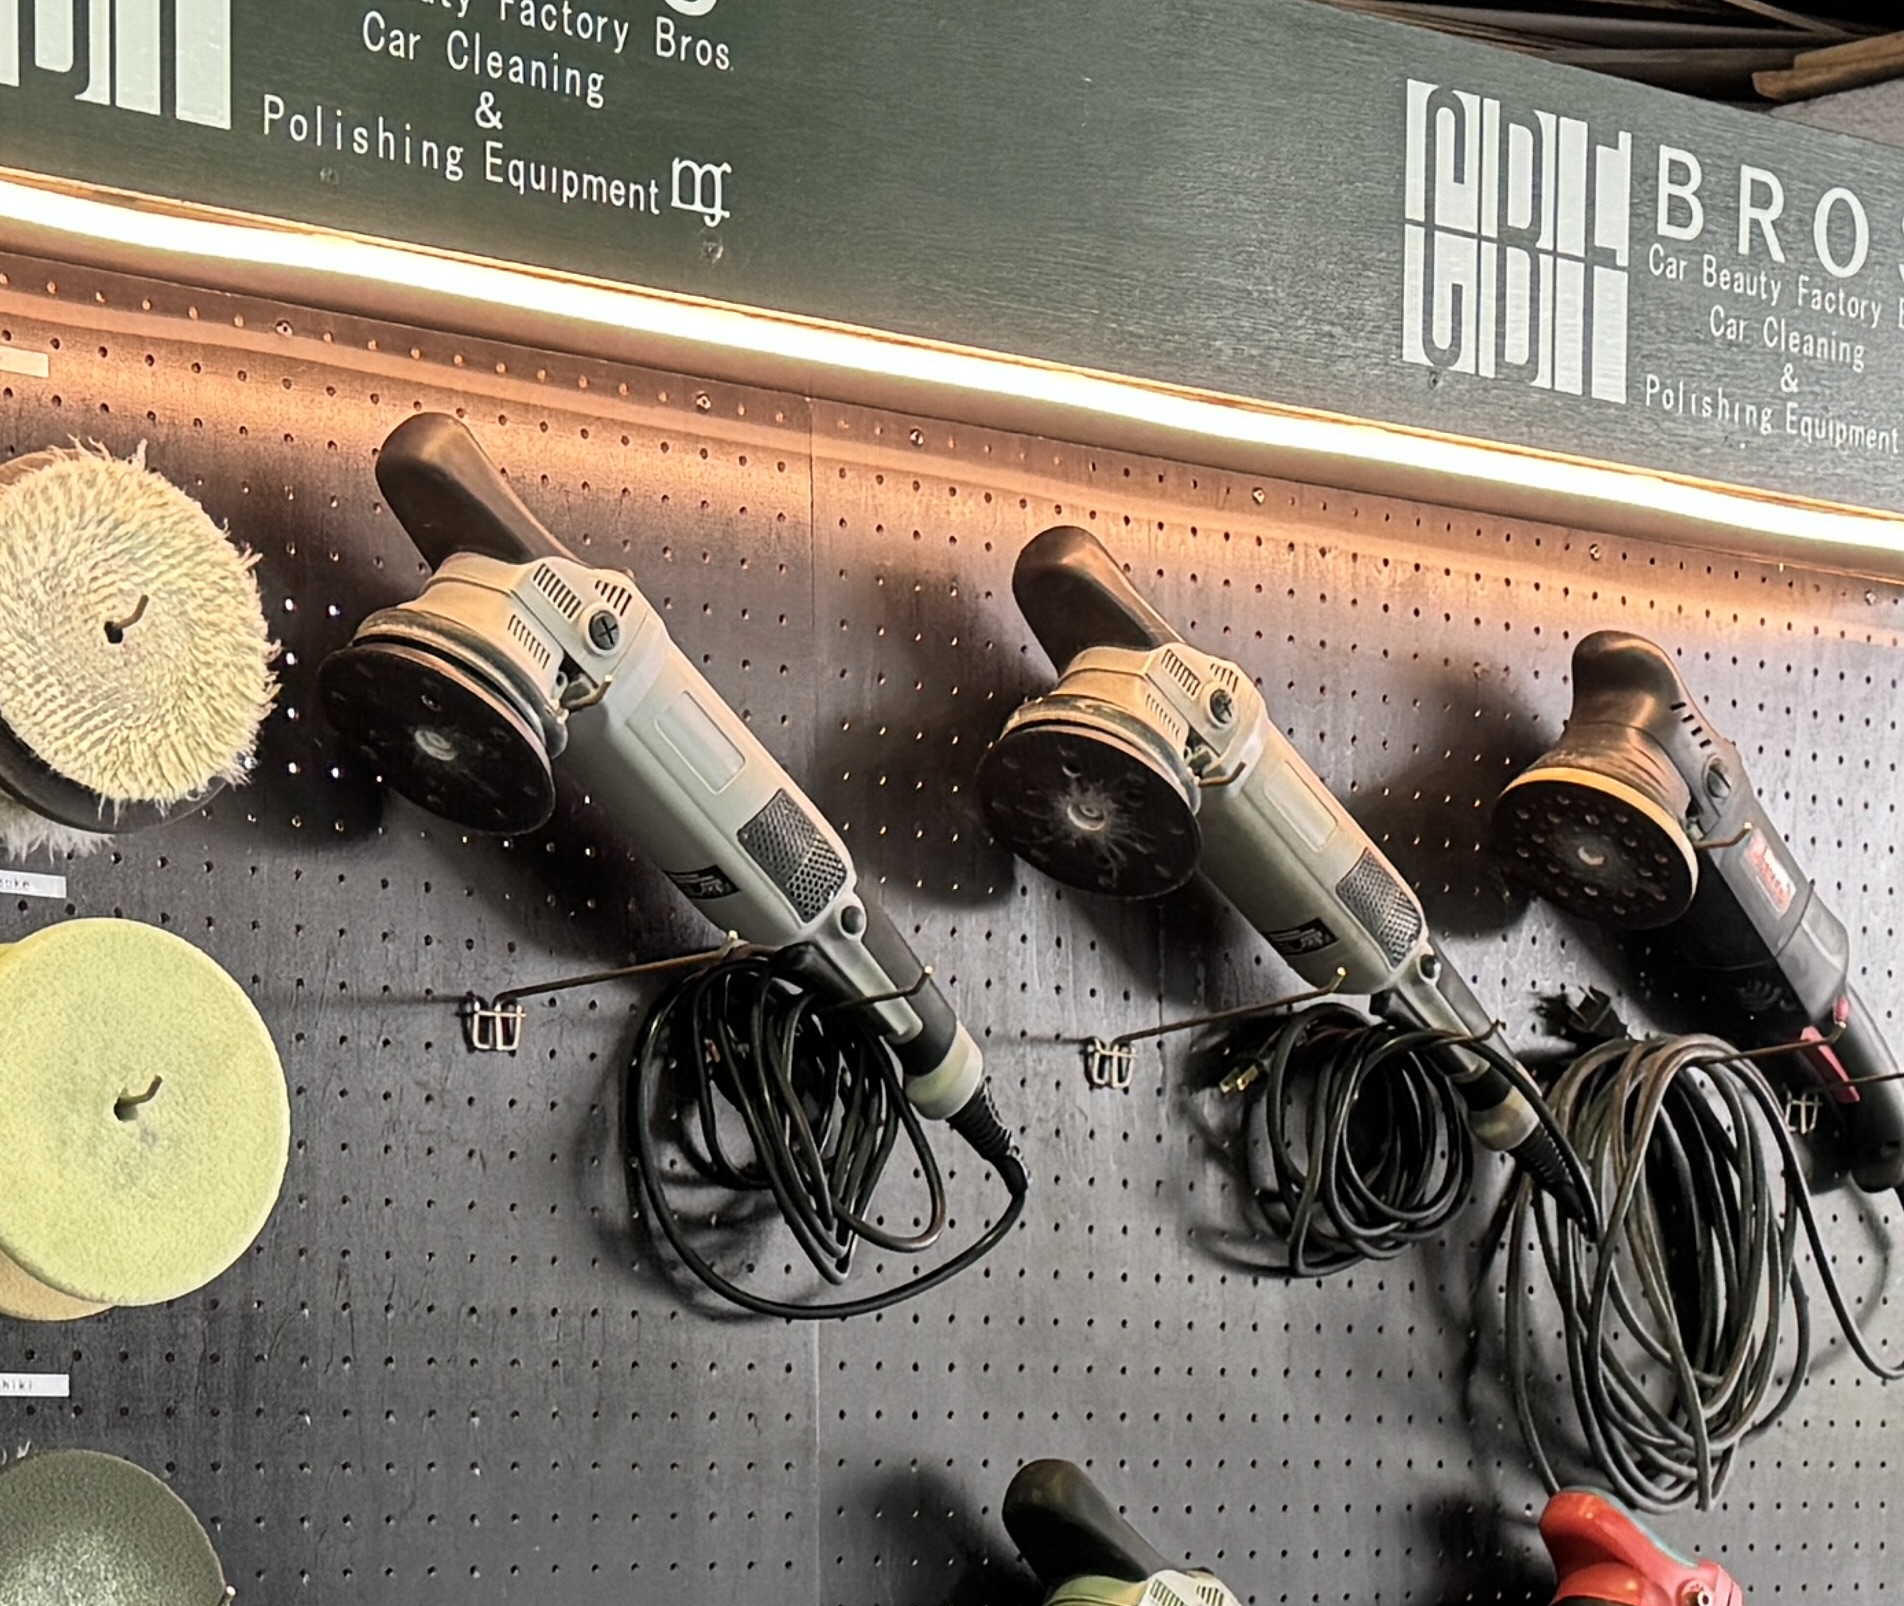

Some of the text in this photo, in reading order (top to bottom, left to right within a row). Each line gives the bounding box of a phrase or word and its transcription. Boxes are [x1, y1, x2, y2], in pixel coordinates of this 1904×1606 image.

[363, 10, 605, 108] Car Cleaning
[475, 91, 504, 130] &
[263, 94, 660, 215] Polishing Equipment
[1648, 242, 1687, 283] Car
[1703, 254, 1782, 306] Beauty
[1797, 275, 1881, 329] Factory
[1710, 305, 1865, 371] Car Cleaning
[1780, 363, 1799, 393] &
[1645, 373, 1900, 453] Polishing Equipment
